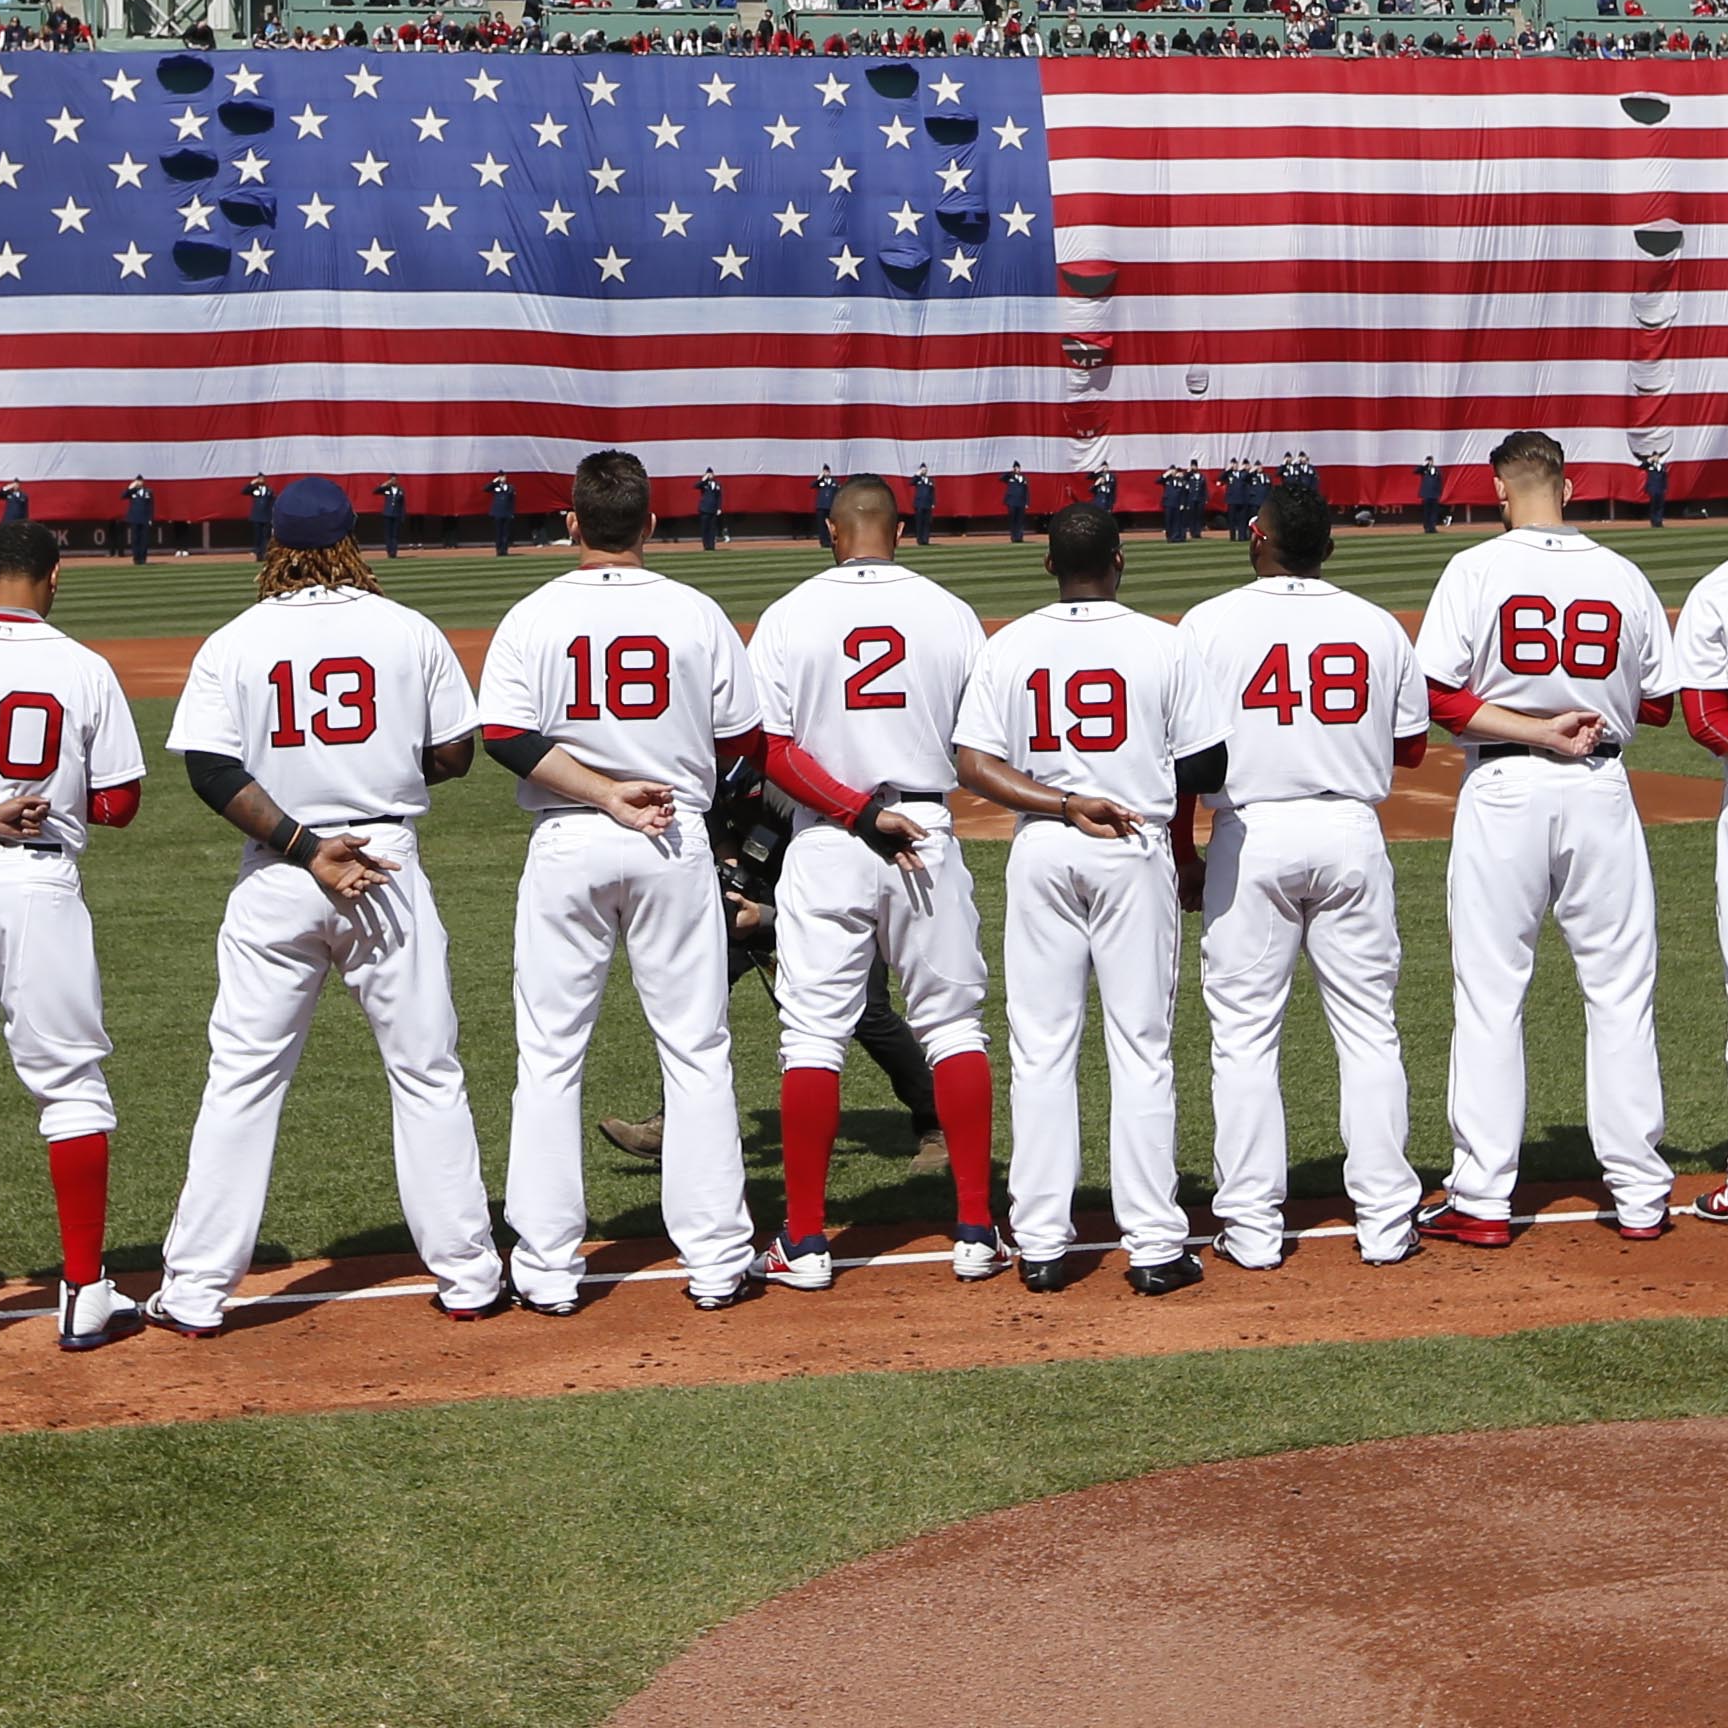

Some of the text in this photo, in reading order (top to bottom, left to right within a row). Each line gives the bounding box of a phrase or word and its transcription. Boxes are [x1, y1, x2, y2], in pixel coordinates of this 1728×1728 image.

[565, 634, 671, 721] 18
[842, 624, 907, 711] 2
[1499, 593, 1622, 680] 68
[267, 655, 376, 749] 13
[1025, 667, 1128, 753] 19
[1241, 641, 1370, 726] 48
